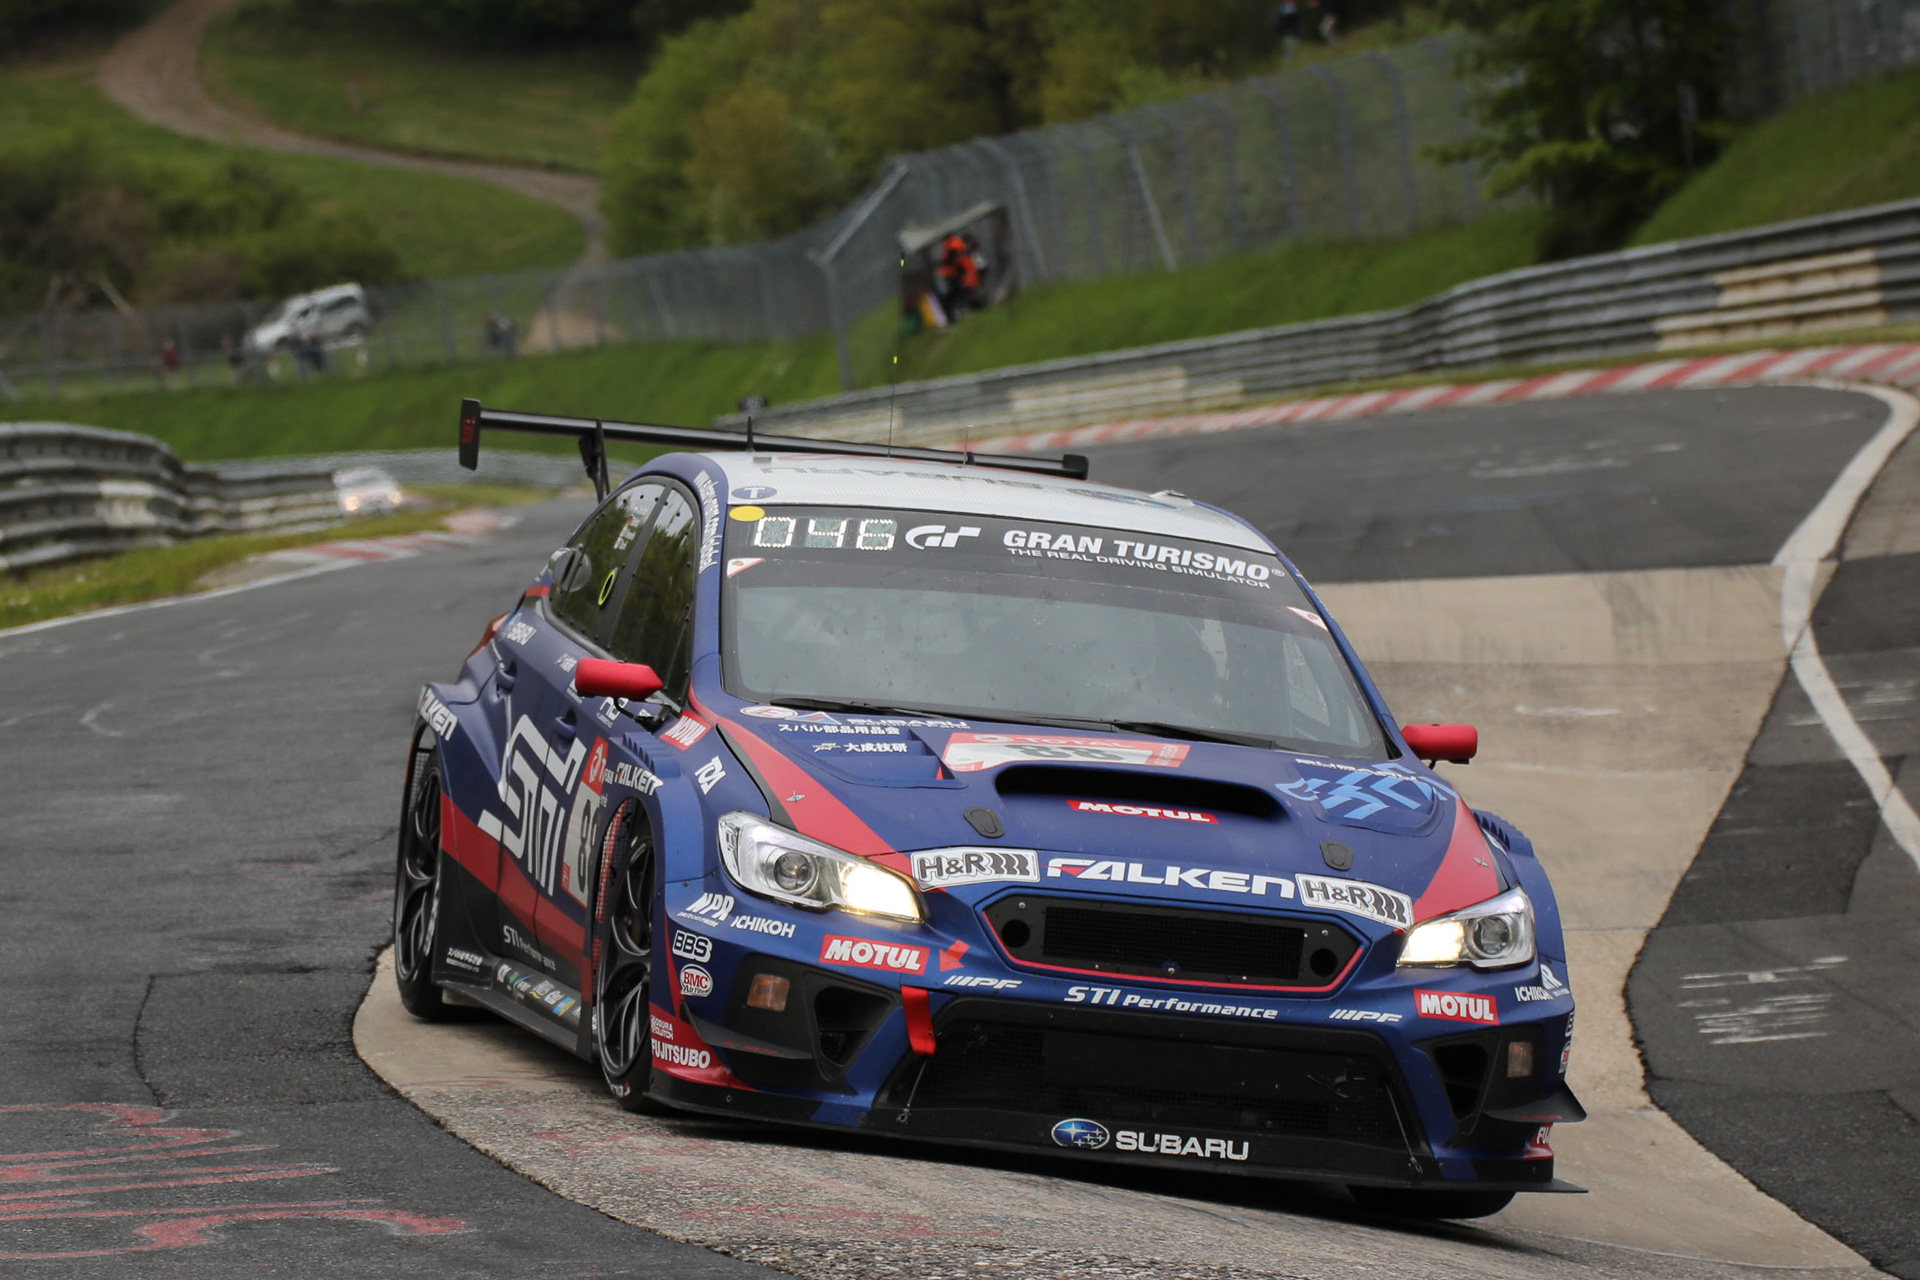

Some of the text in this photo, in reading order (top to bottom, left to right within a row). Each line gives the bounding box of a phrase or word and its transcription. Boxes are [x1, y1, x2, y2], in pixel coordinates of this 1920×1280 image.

[754, 516, 896, 551] 046
[1003, 529, 1104, 555] GRAN
[1007, 548, 1271, 590] THE REAL DRIVING SIMULATOR
[664, 715, 707, 747] MOTUL
[1015, 736, 1136, 749] TOTAL
[1006, 744, 1125, 762] 88
[614, 762, 664, 797] FALKEN
[1078, 802, 1212, 823] MOTUL
[919, 852, 987, 880] H&R
[1047, 858, 1296, 900] FALKEN
[685, 892, 735, 921] NPR
[1302, 879, 1370, 909] H&R
[730, 915, 797, 939] ICHIKOH
[673, 930, 712, 961] BBS
[824, 939, 923, 971] MOTUL
[682, 971, 709, 989] BMC
[1064, 986, 1279, 1020] STI Performance
[1420, 993, 1495, 1022] MOTUL
[651, 1038, 711, 1069] FUJITSUBO
[1115, 1130, 1250, 1161] SUBARU
